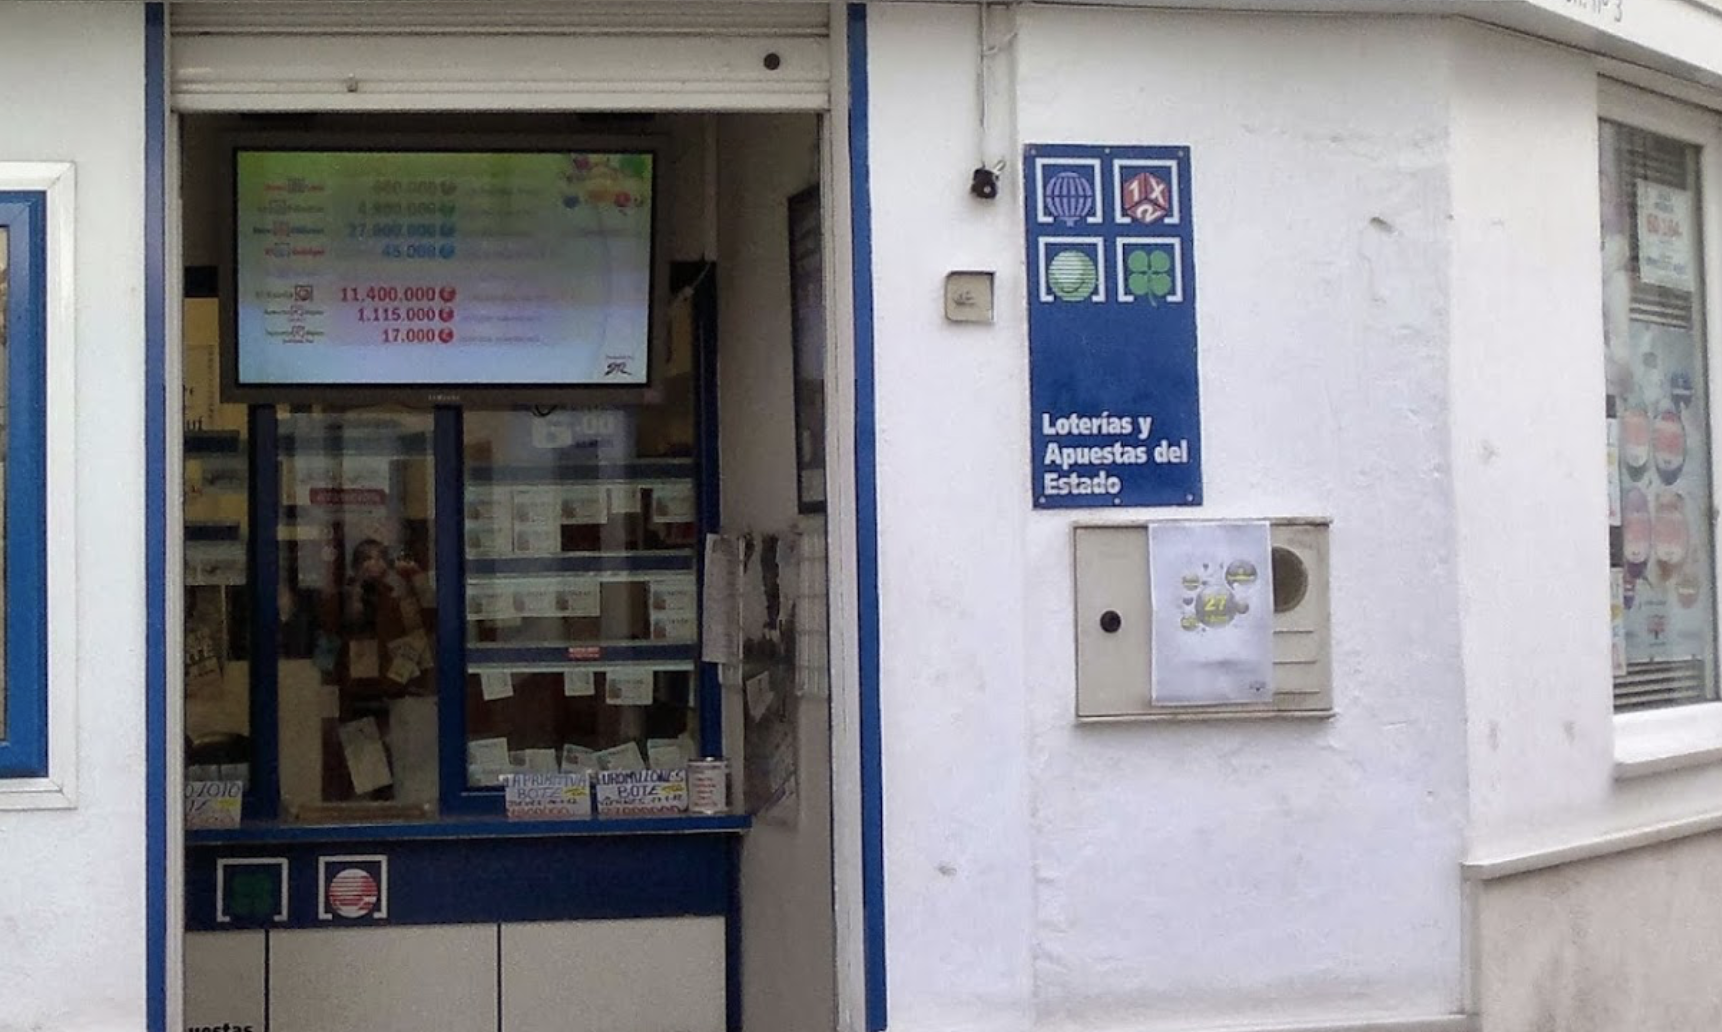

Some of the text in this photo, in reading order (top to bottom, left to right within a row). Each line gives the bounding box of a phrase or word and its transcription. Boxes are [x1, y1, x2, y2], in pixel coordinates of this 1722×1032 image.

[340, 286, 436, 302] 11.400.000
[357, 307, 436, 322] 1.115.000
[382, 328, 436, 343] 17.000
[1042, 412, 1152, 439] Loterías y
[1044, 440, 1188, 470] Apuestas del
[1044, 470, 1122, 495] Estado
[1204, 594, 1228, 611] 27
[617, 785, 658, 798] BOTE
